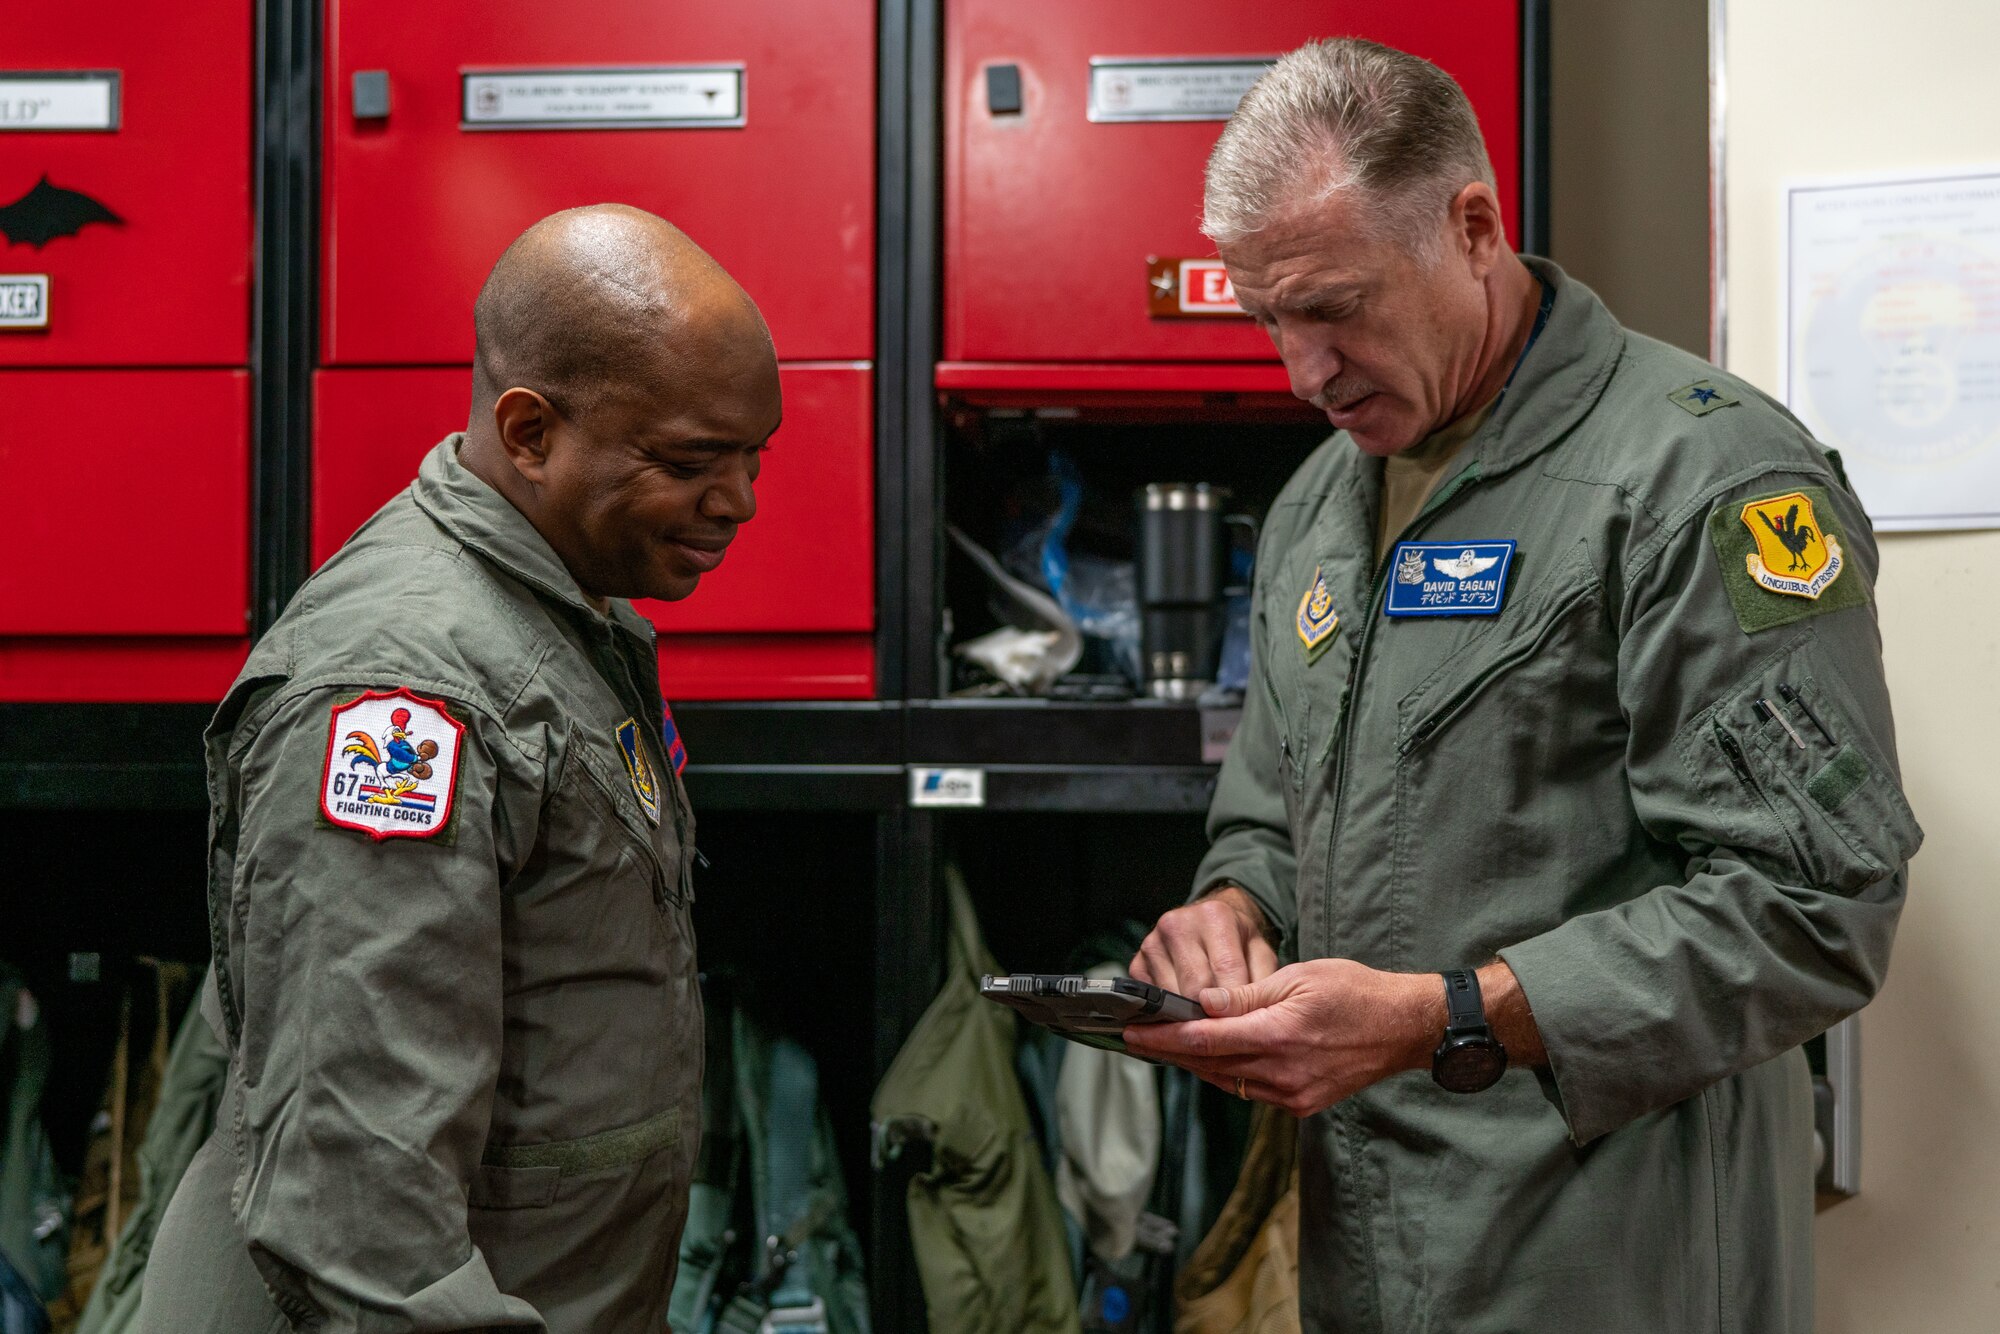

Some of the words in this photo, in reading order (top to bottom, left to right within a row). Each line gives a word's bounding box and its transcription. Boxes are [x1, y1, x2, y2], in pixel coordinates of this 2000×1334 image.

[0, 284, 39, 315] KER
[1423, 581, 1456, 593] DAVID
[1459, 580, 1496, 592] EAGLIN
[1761, 573, 1810, 594] UNGUIBUS
[1820, 557, 1840, 585] ROSTRO
[336, 801, 391, 818] FIGHTING
[393, 809, 432, 825] COCKS
